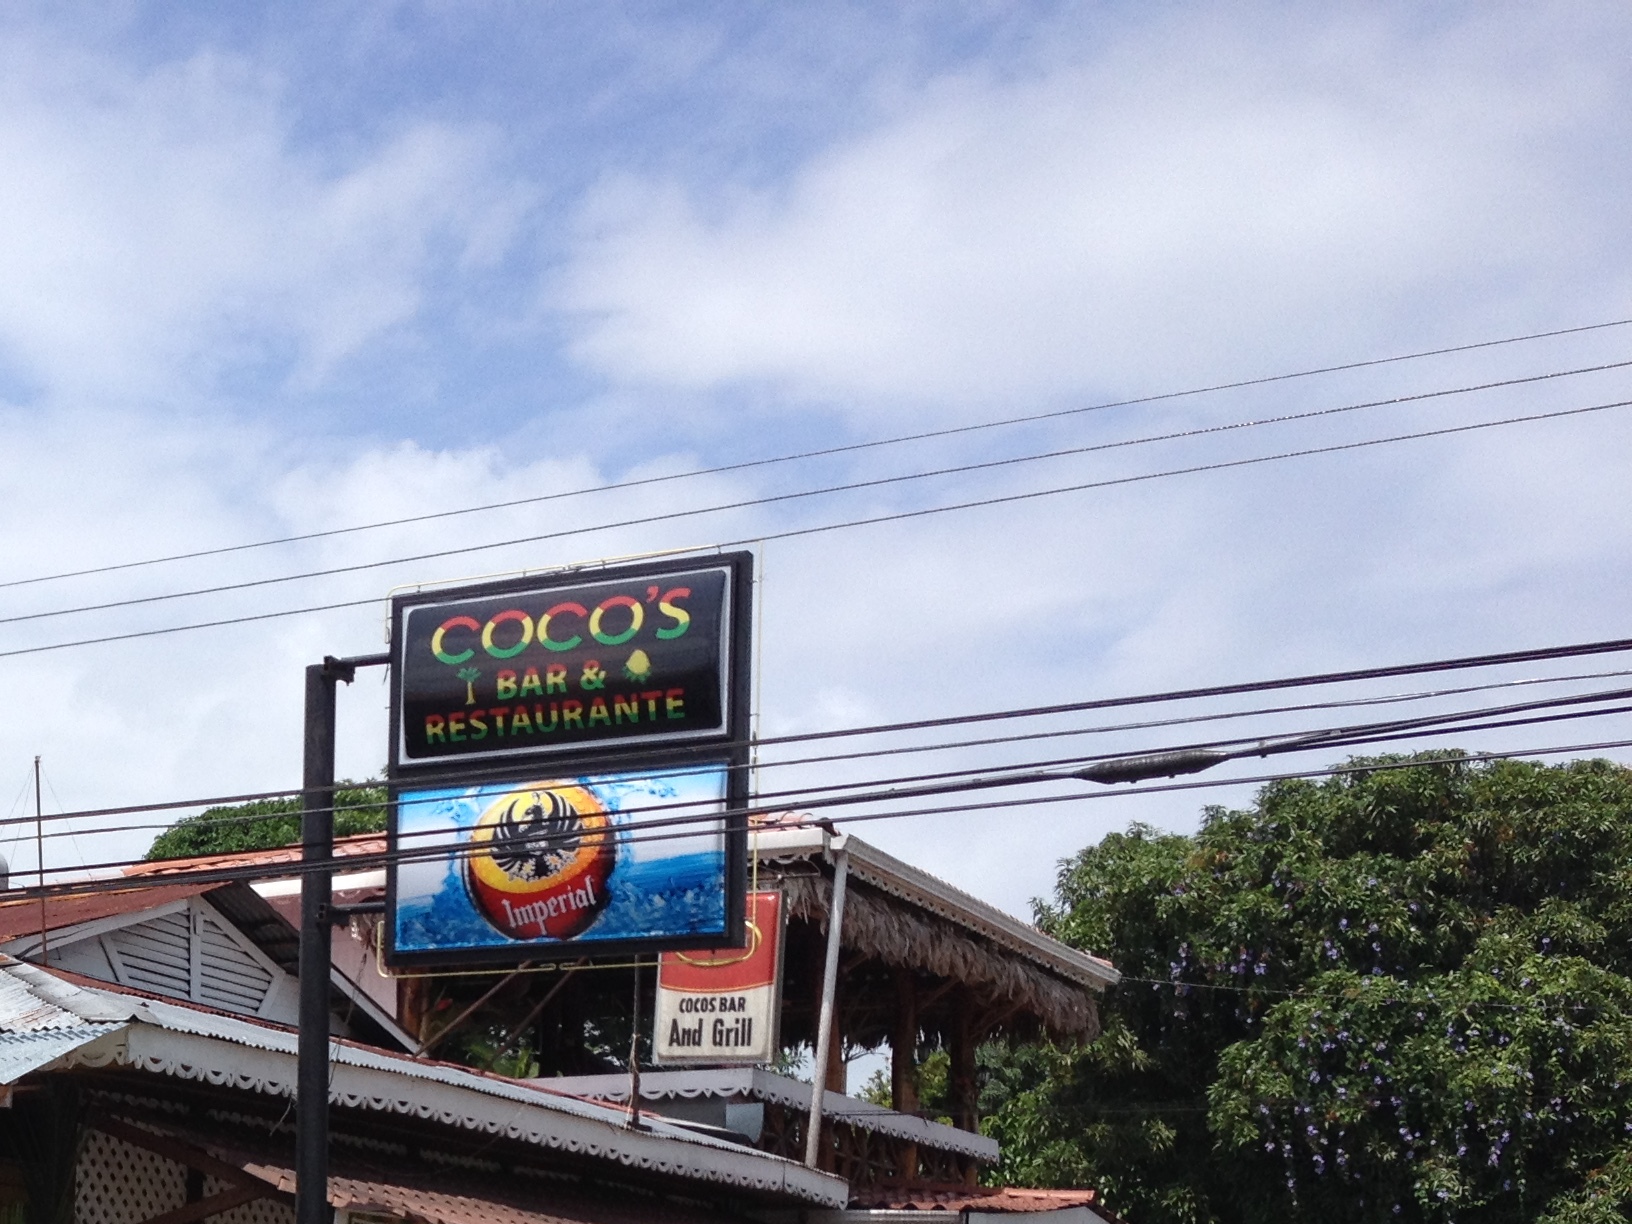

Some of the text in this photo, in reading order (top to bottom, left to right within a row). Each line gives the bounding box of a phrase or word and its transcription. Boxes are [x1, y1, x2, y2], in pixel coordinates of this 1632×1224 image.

[431, 586, 692, 665] COCO'S
[496, 659, 607, 700] BAR &
[424, 688, 686, 745] RESTAURANTE
[501, 875, 597, 936] Imperial
[679, 996, 747, 1013] COCOS BAR
[668, 1017, 753, 1047] And Grill
